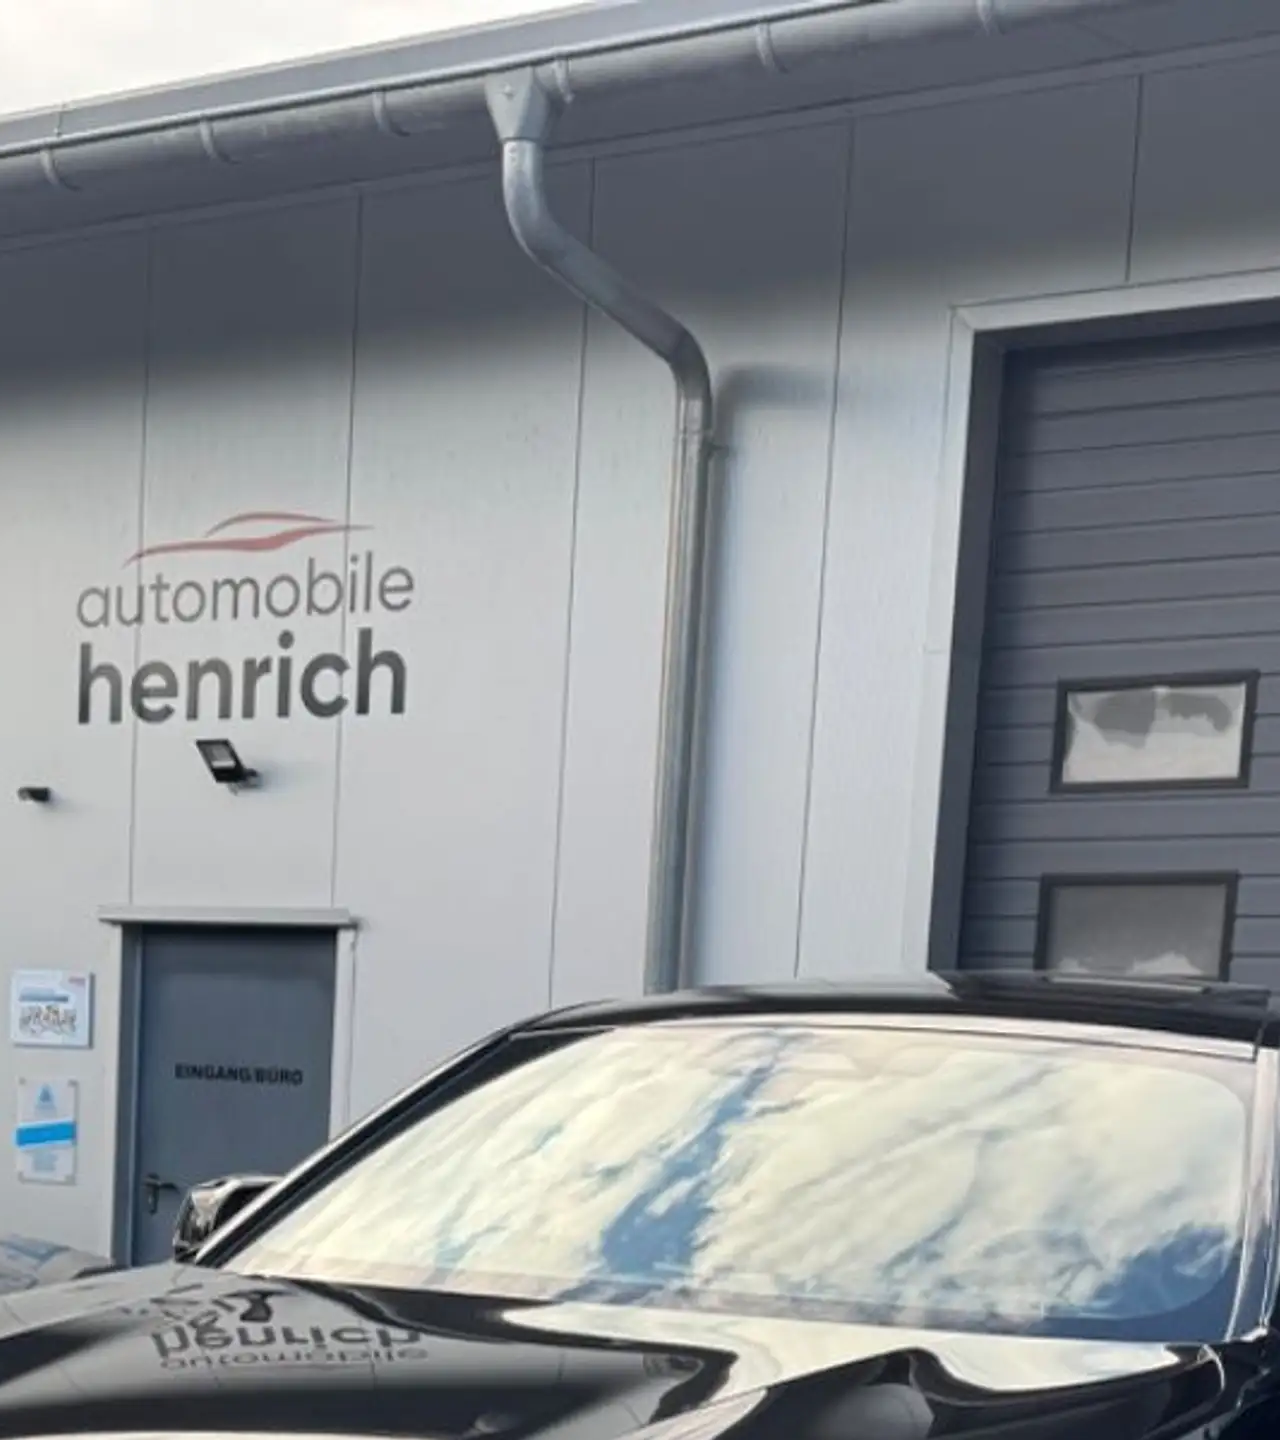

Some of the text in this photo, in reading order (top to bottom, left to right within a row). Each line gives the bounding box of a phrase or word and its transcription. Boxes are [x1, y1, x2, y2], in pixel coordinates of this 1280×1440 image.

[76, 550, 414, 628] automobile
[77, 627, 407, 724] henrich
[175, 1062, 252, 1084] EINGANG
